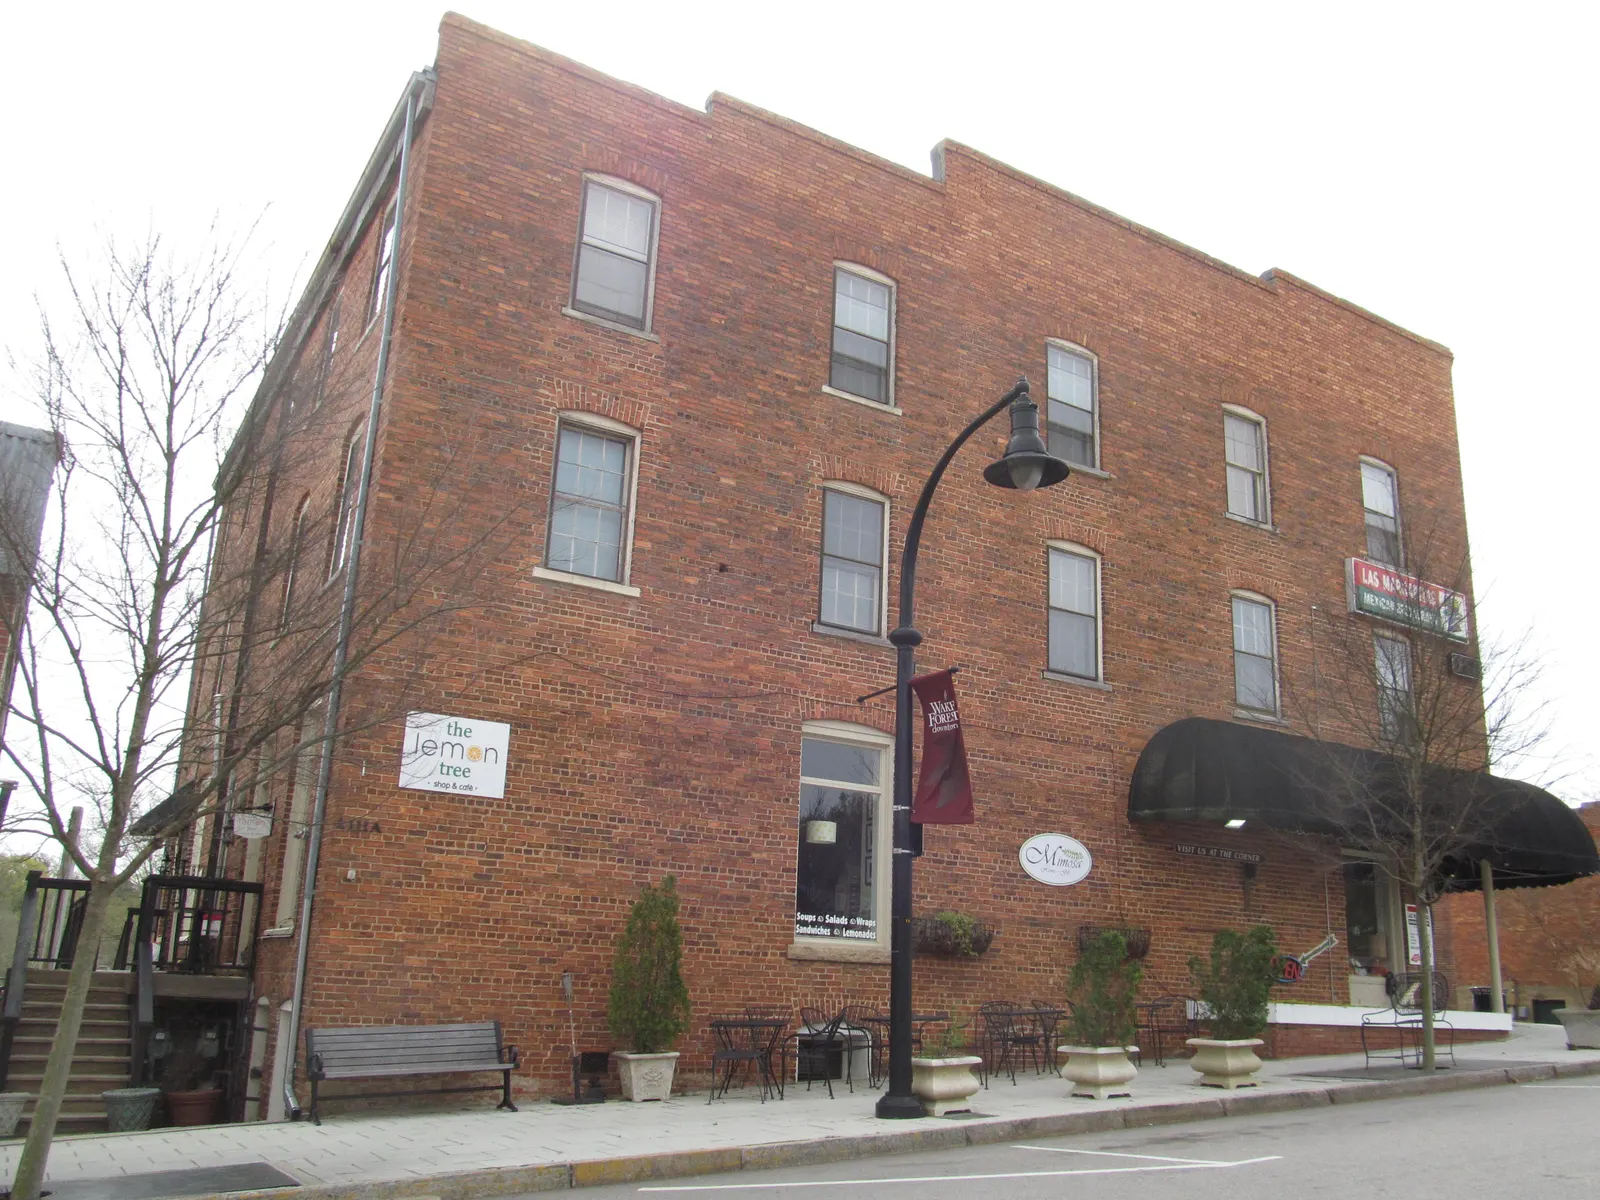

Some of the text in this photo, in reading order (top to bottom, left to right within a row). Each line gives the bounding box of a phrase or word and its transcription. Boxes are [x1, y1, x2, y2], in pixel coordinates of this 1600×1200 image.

[1362, 568, 1437, 607] LAS MARARIAS
[1363, 592, 1395, 611] MEXICAN
[928, 711, 959, 727] FORET
[447, 721, 472, 738] the
[415, 732, 498, 764] lemon
[439, 762, 471, 778] tree
[434, 781, 451, 790] shop
[1026, 844, 1083, 868] Mimosa
[1177, 844, 1260, 861] VISIT US AT THE CORNER
[796, 912, 876, 927] Soups Salads Wraps
[796, 924, 876, 939] Sandwiches Lemonades
